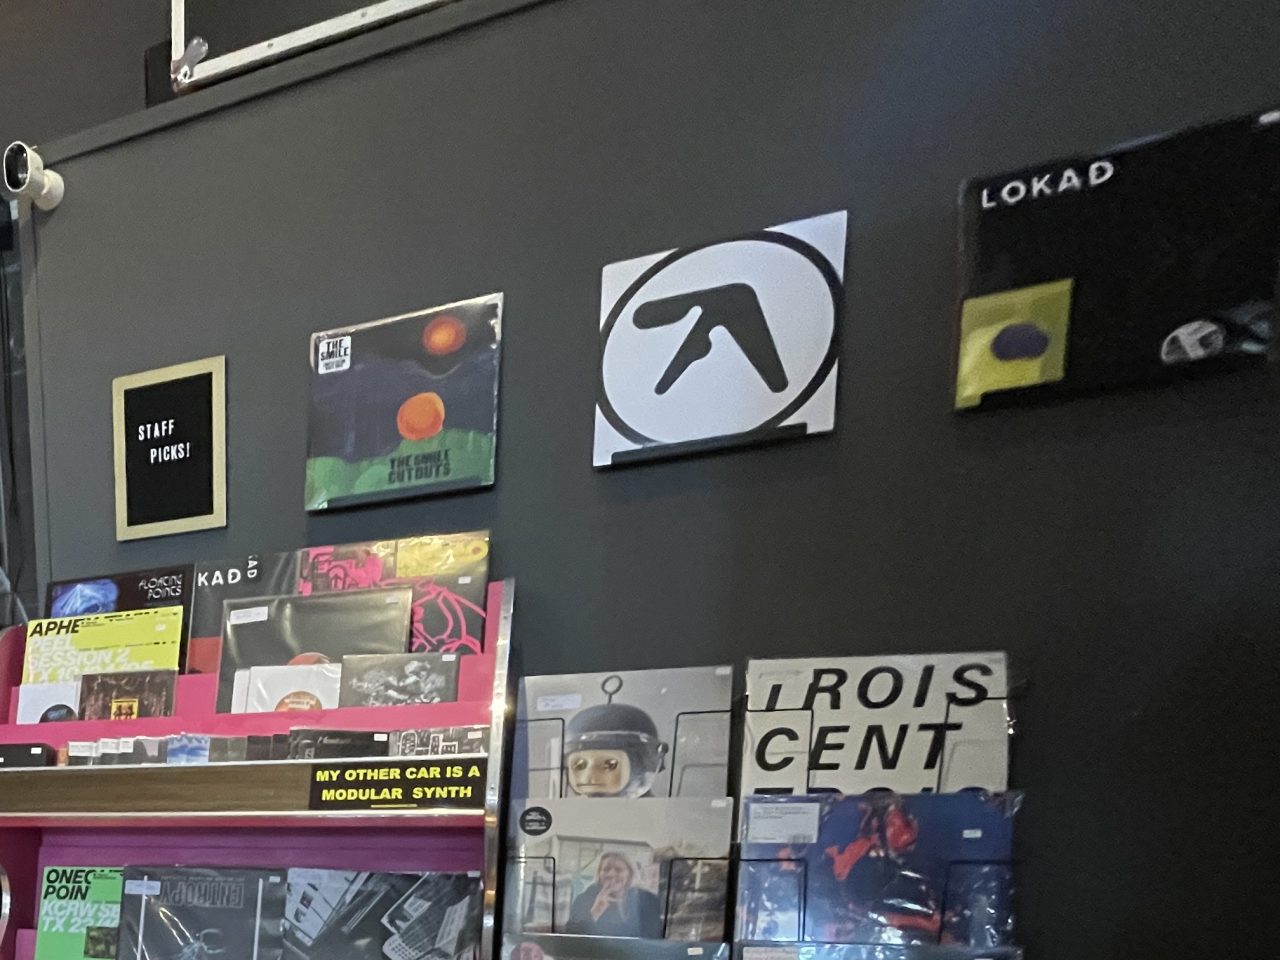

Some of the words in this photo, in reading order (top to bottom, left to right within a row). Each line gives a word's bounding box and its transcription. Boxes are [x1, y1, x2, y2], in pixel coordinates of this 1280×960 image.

[982, 161, 1114, 208] LOKAD
[320, 346, 349, 361] SMILE
[326, 338, 344, 350] THE
[138, 419, 175, 441] STAFF
[150, 442, 190, 464] PICKS!
[755, 722, 963, 772] CENT
[316, 770, 341, 781] MY
[345, 768, 401, 781] OTHER
[405, 766, 441, 779] CAR
[446, 765, 463, 778] IS
[468, 765, 481, 777] A
[321, 788, 403, 801] MODULAR
[412, 786, 473, 799] SYNTH
